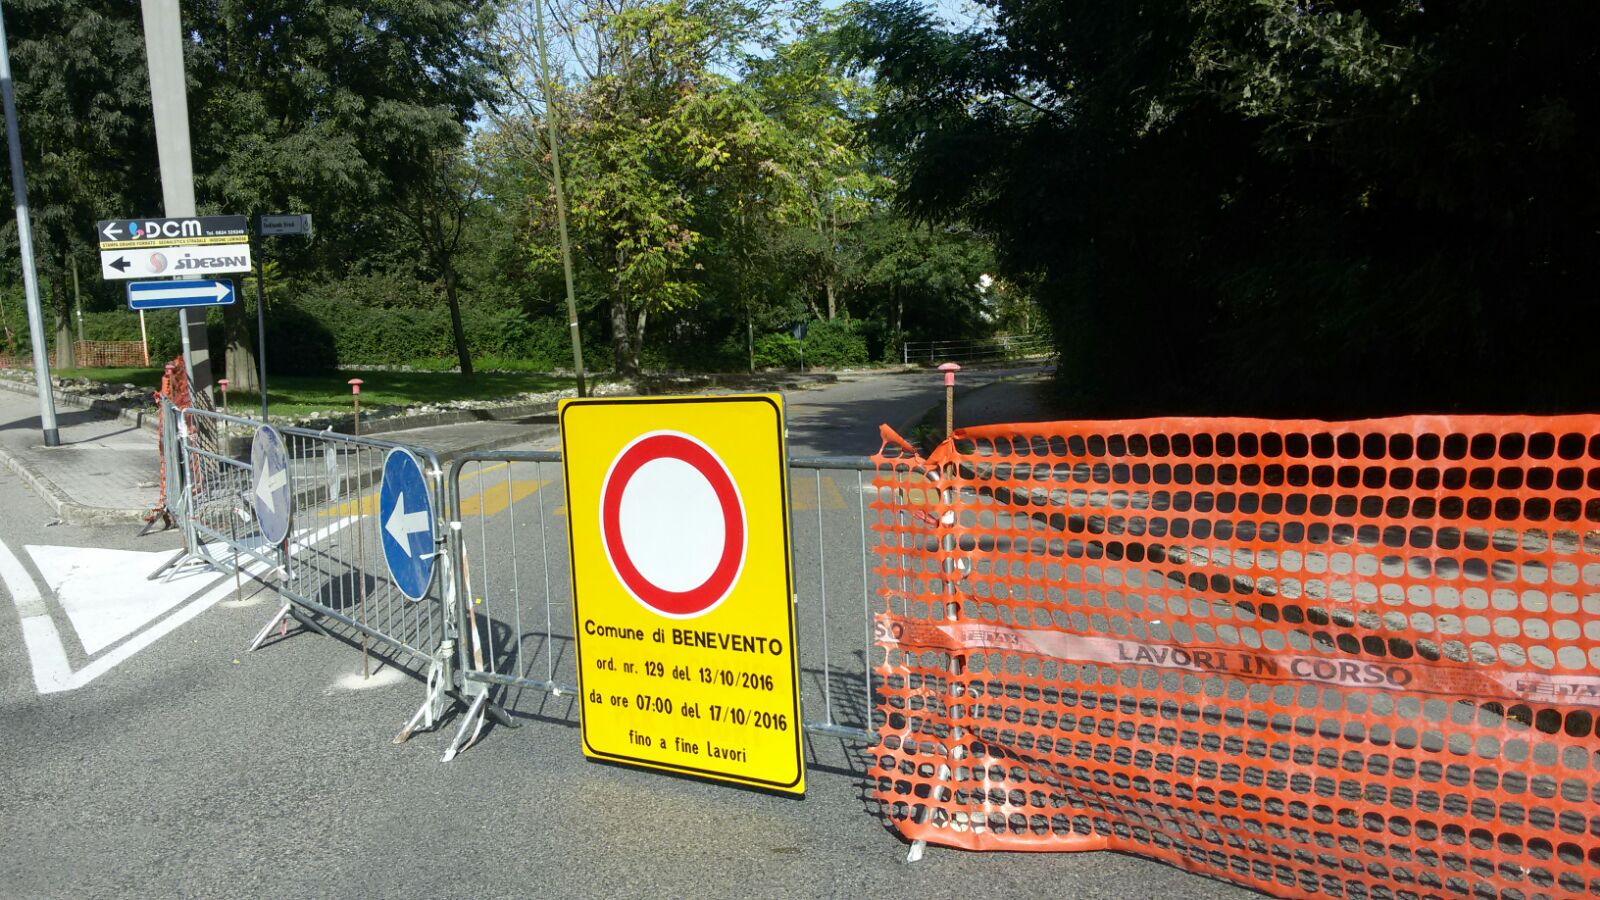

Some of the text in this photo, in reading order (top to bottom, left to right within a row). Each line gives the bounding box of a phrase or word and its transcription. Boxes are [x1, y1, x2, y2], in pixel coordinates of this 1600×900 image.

[145, 220, 202, 238] DCM
[584, 619, 783, 656] Comune di BENEVENTO
[596, 657, 774, 692] ord. nr. 129 del 13/10/2016
[1117, 642, 1229, 672] LAVORI
[1240, 655, 1278, 676] IN
[1290, 658, 1413, 687] CORSO
[589, 689, 787, 732] da ore 07:00 del 17/10/2016
[628, 730, 652, 747] fino
[659, 739, 667, 750] a
[675, 737, 699, 755] fine
